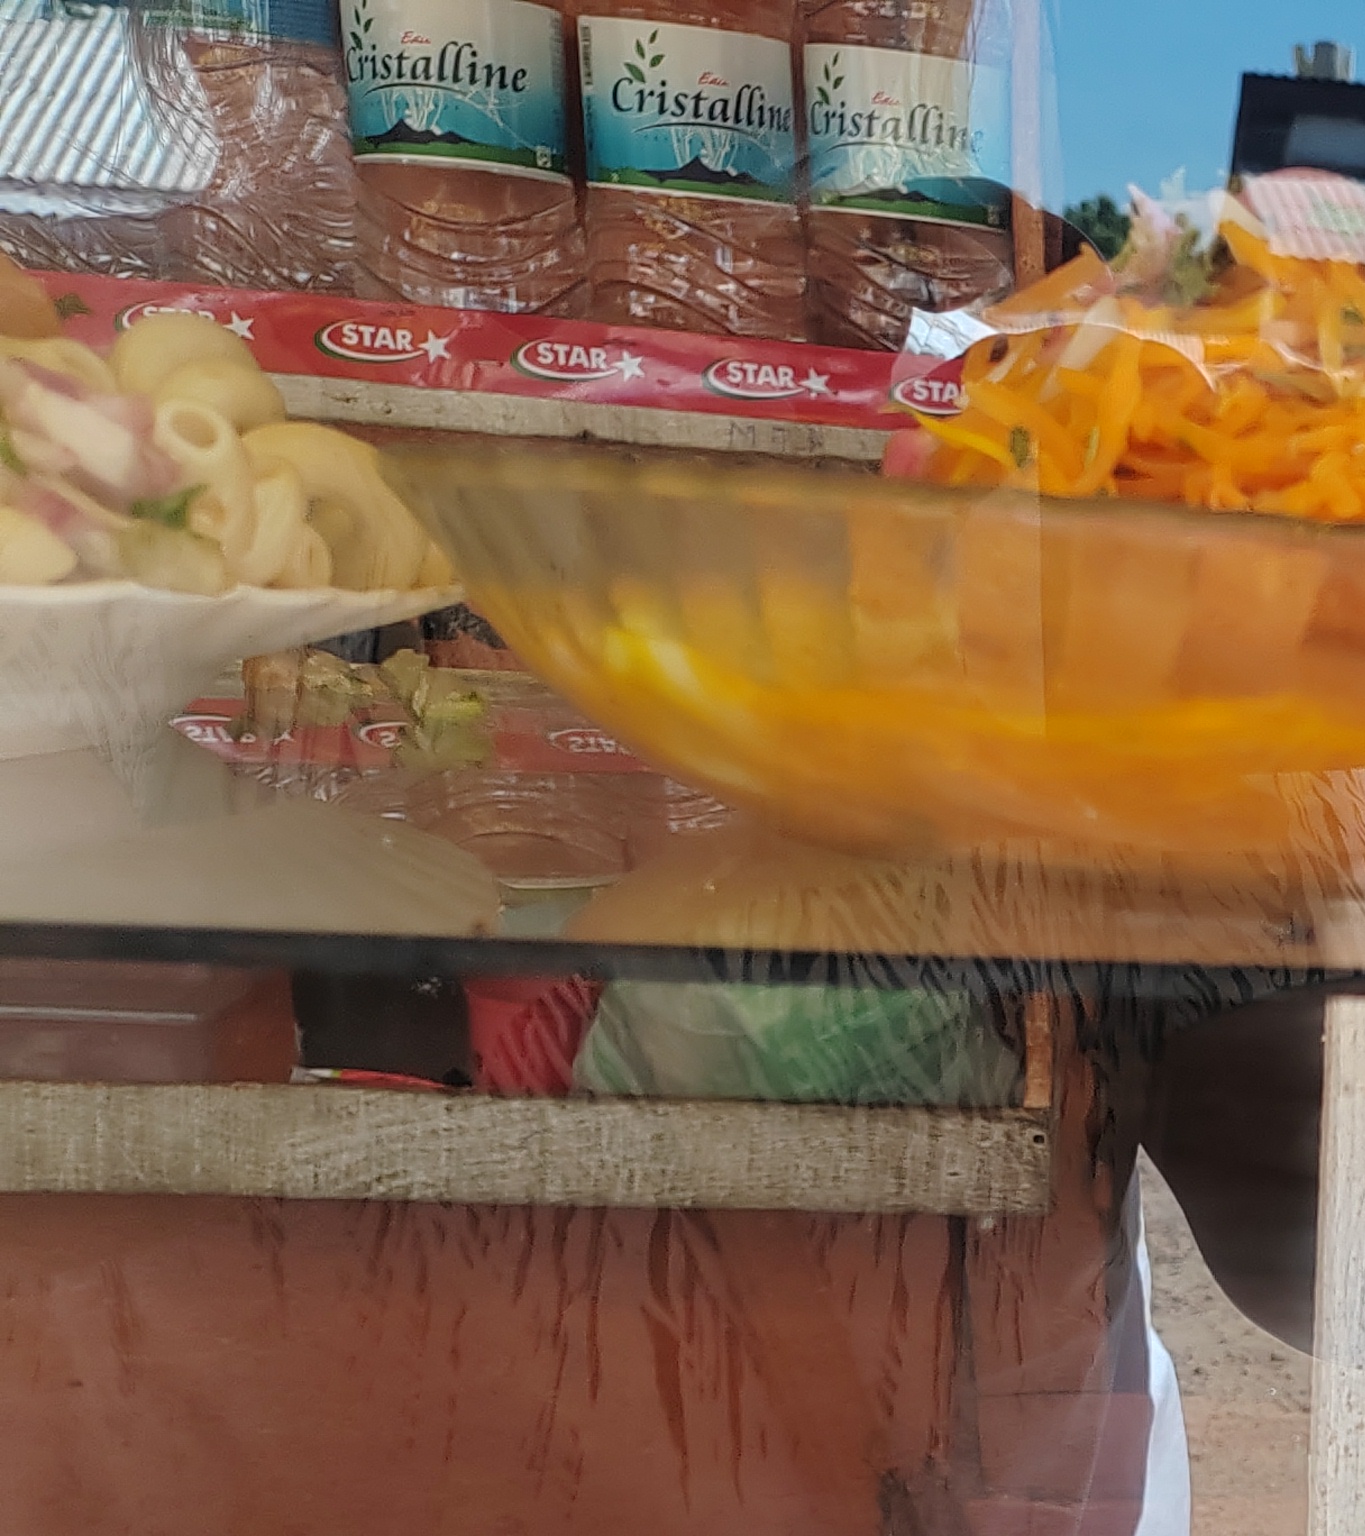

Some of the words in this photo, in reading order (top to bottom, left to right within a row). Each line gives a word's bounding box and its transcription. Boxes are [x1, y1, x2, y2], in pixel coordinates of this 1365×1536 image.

[347, 41, 528, 93] Cristalline
[612, 77, 792, 132] Cristalline
[341, 323, 415, 351] STAR
[536, 342, 608, 370] STAR
[726, 361, 796, 389] STAR
[912, 380, 966, 403] STA
